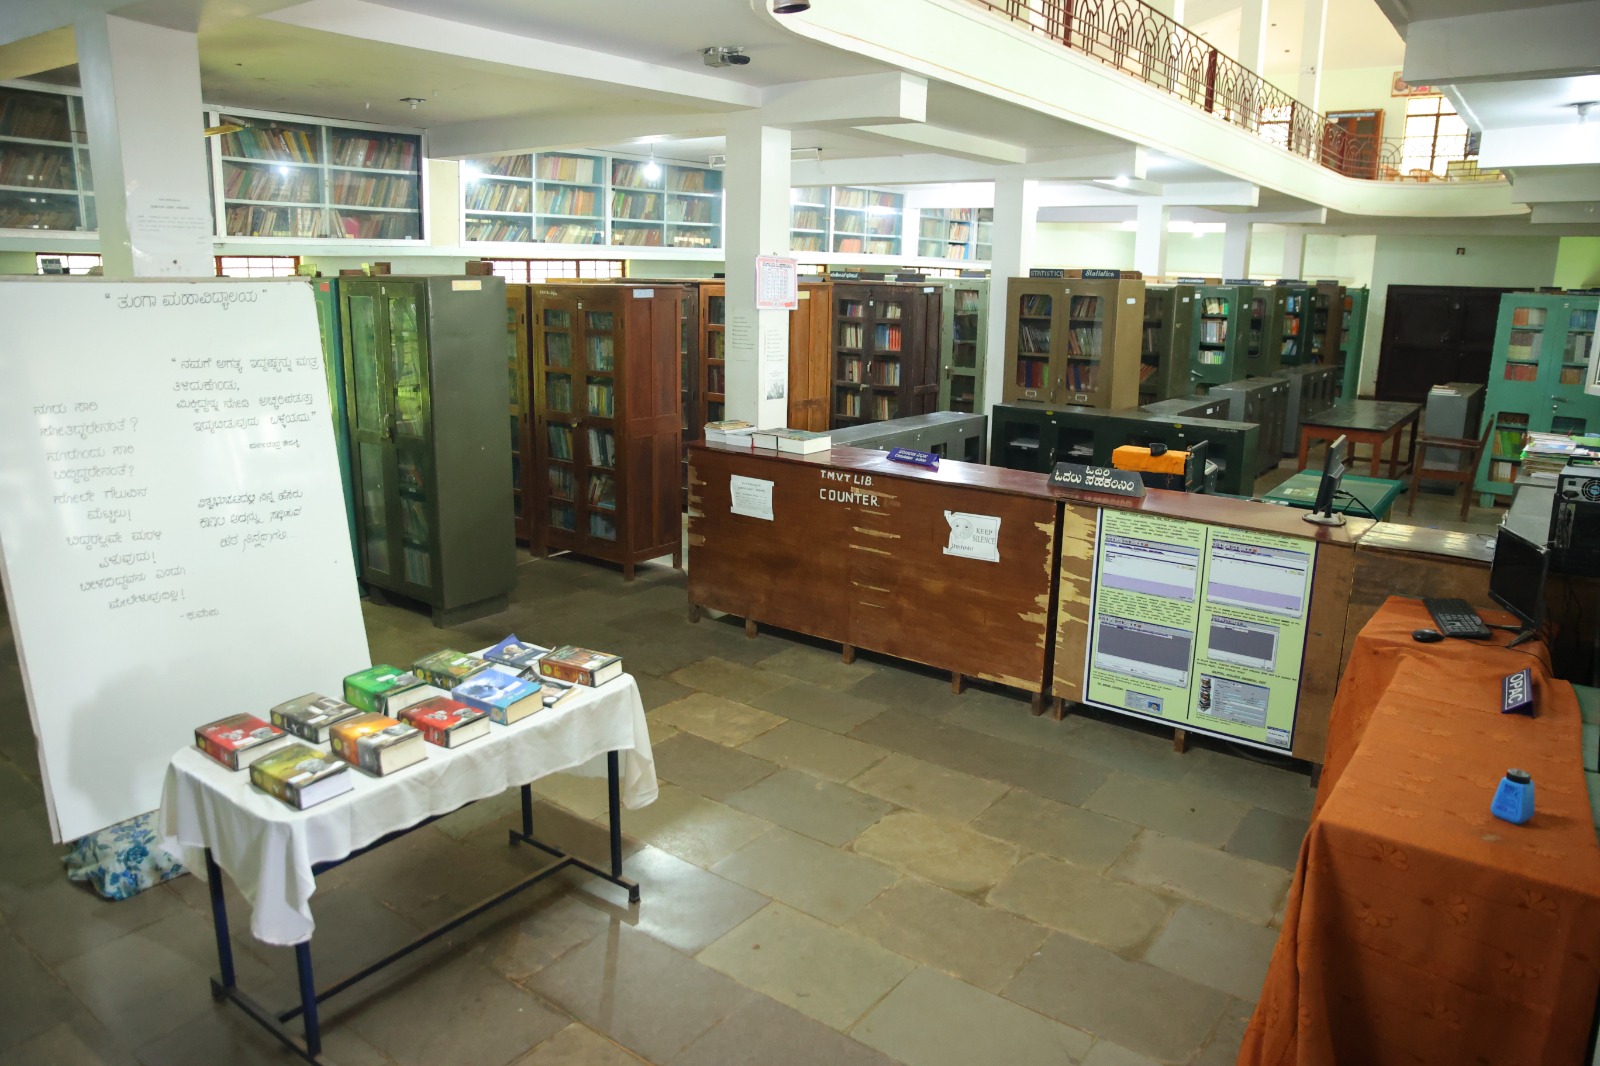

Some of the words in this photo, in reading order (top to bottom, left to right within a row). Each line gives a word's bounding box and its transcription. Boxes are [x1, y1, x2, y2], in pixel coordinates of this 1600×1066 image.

[1054, 470, 1082, 484] ಓದಲು
[976, 527, 993, 536] KEEP
[972, 534, 996, 545] SILENCE
[1508, 673, 1524, 704] OPAC
